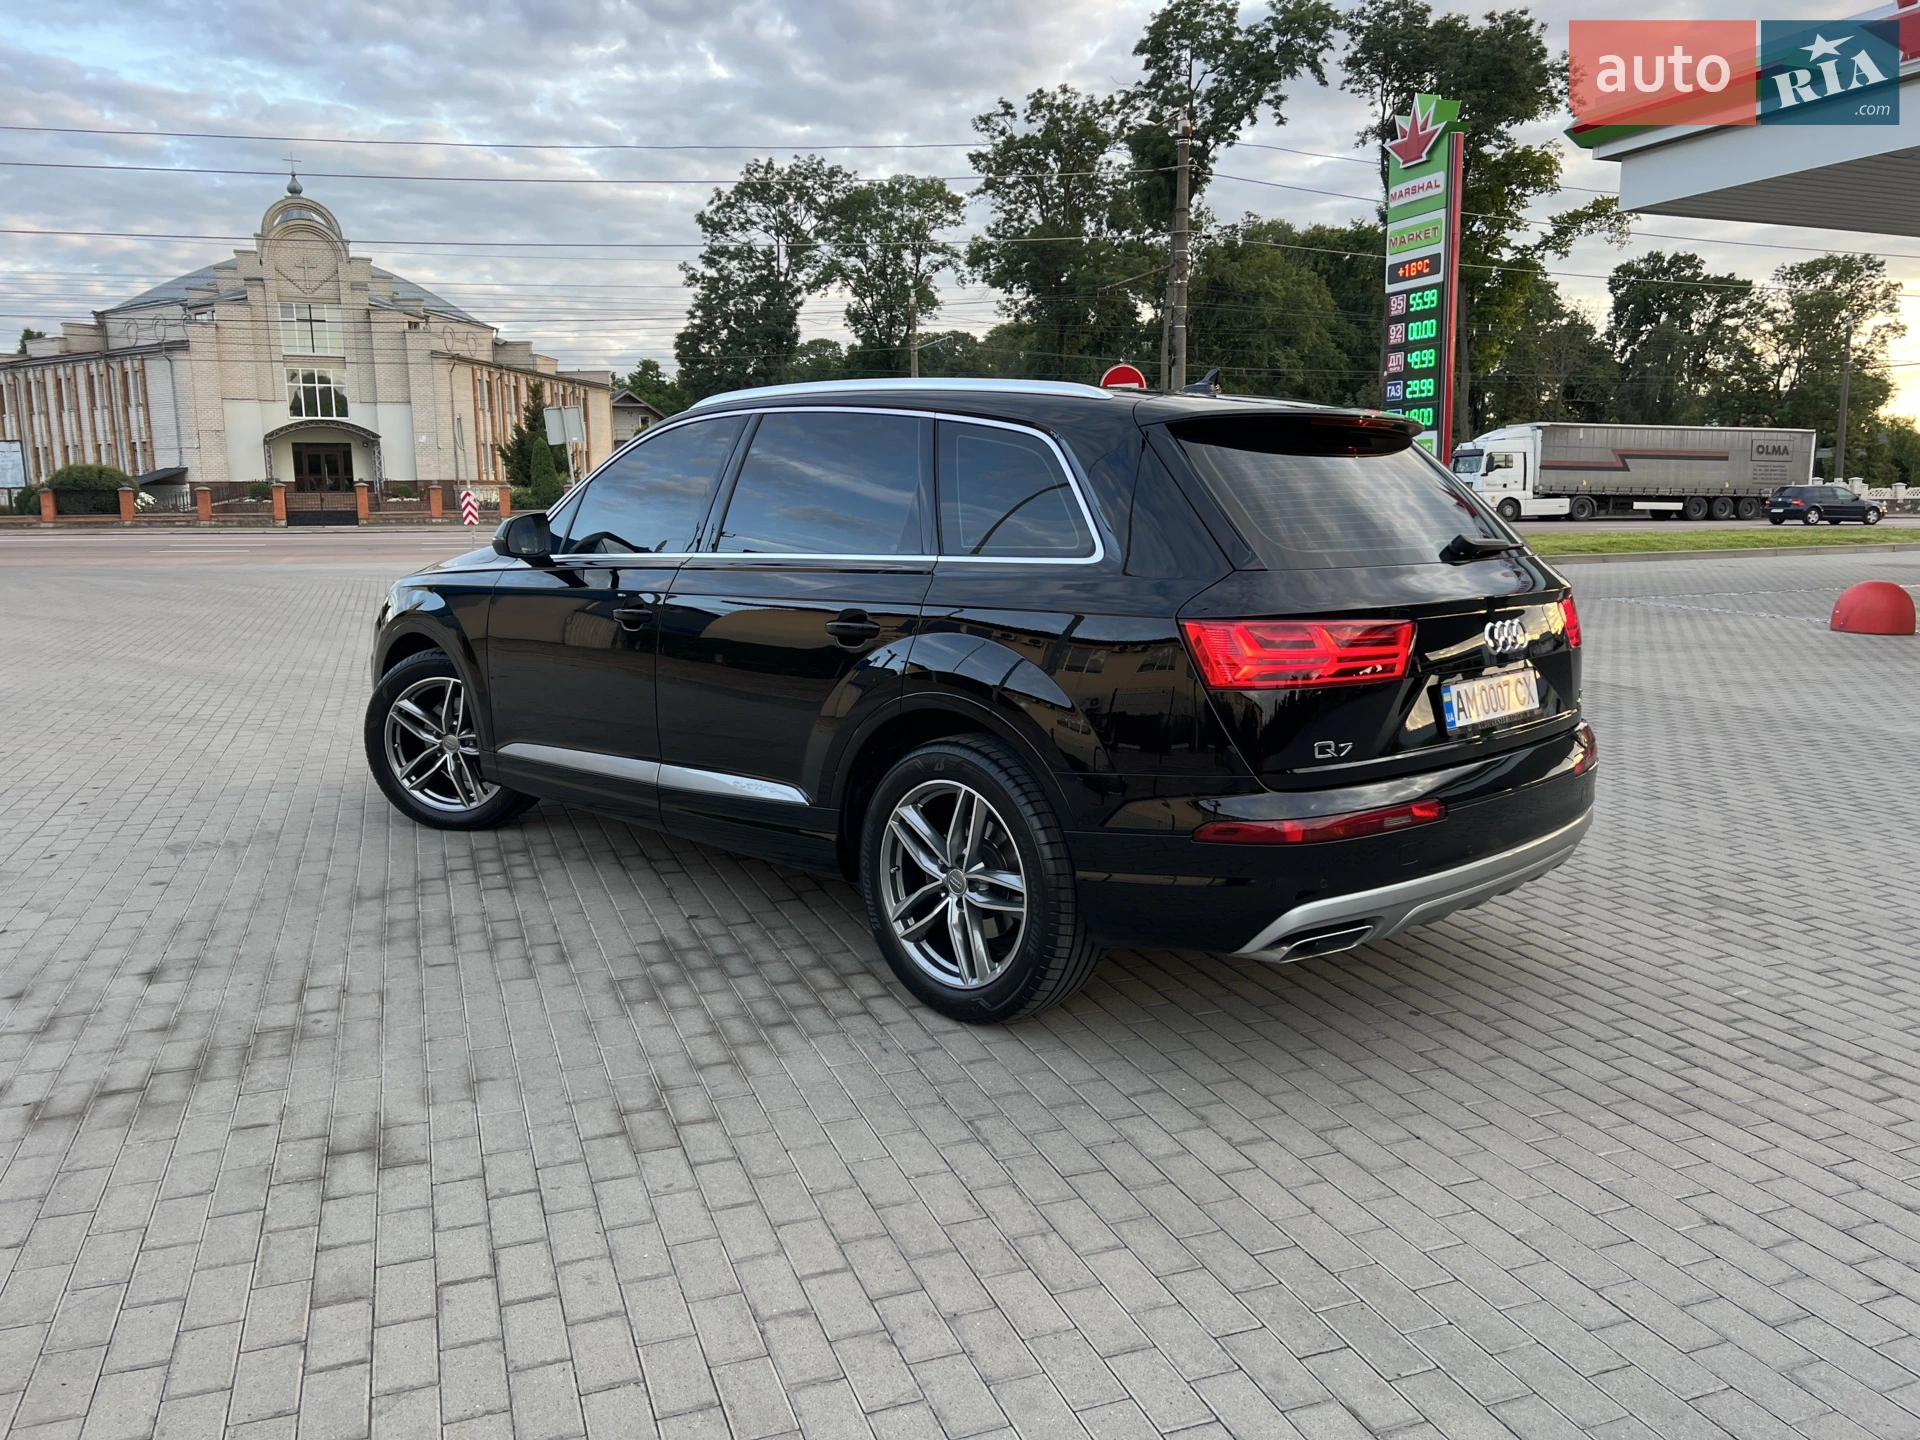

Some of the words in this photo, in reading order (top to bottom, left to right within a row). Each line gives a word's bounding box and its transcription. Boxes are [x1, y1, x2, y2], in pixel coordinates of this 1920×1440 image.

[1390, 179, 1441, 203] MARSHAL
[1391, 296, 1404, 311] 95
[1410, 289, 1438, 312] 55.99
[1390, 326, 1402, 340] 92
[1408, 319, 1437, 341] 00.00
[1388, 354, 1402, 368] ДП
[1407, 349, 1436, 370] 49.99
[1387, 385, 1401, 398] ГАЗ
[1406, 378, 1435, 399] 29.99
[1756, 444, 1790, 456] OLMA
[1456, 686, 1480, 721] AM
[1480, 679, 1511, 715] 0007
[1515, 674, 1535, 706] CX
[1446, 712, 1454, 722] UA
[1313, 740, 1353, 759] Q7
